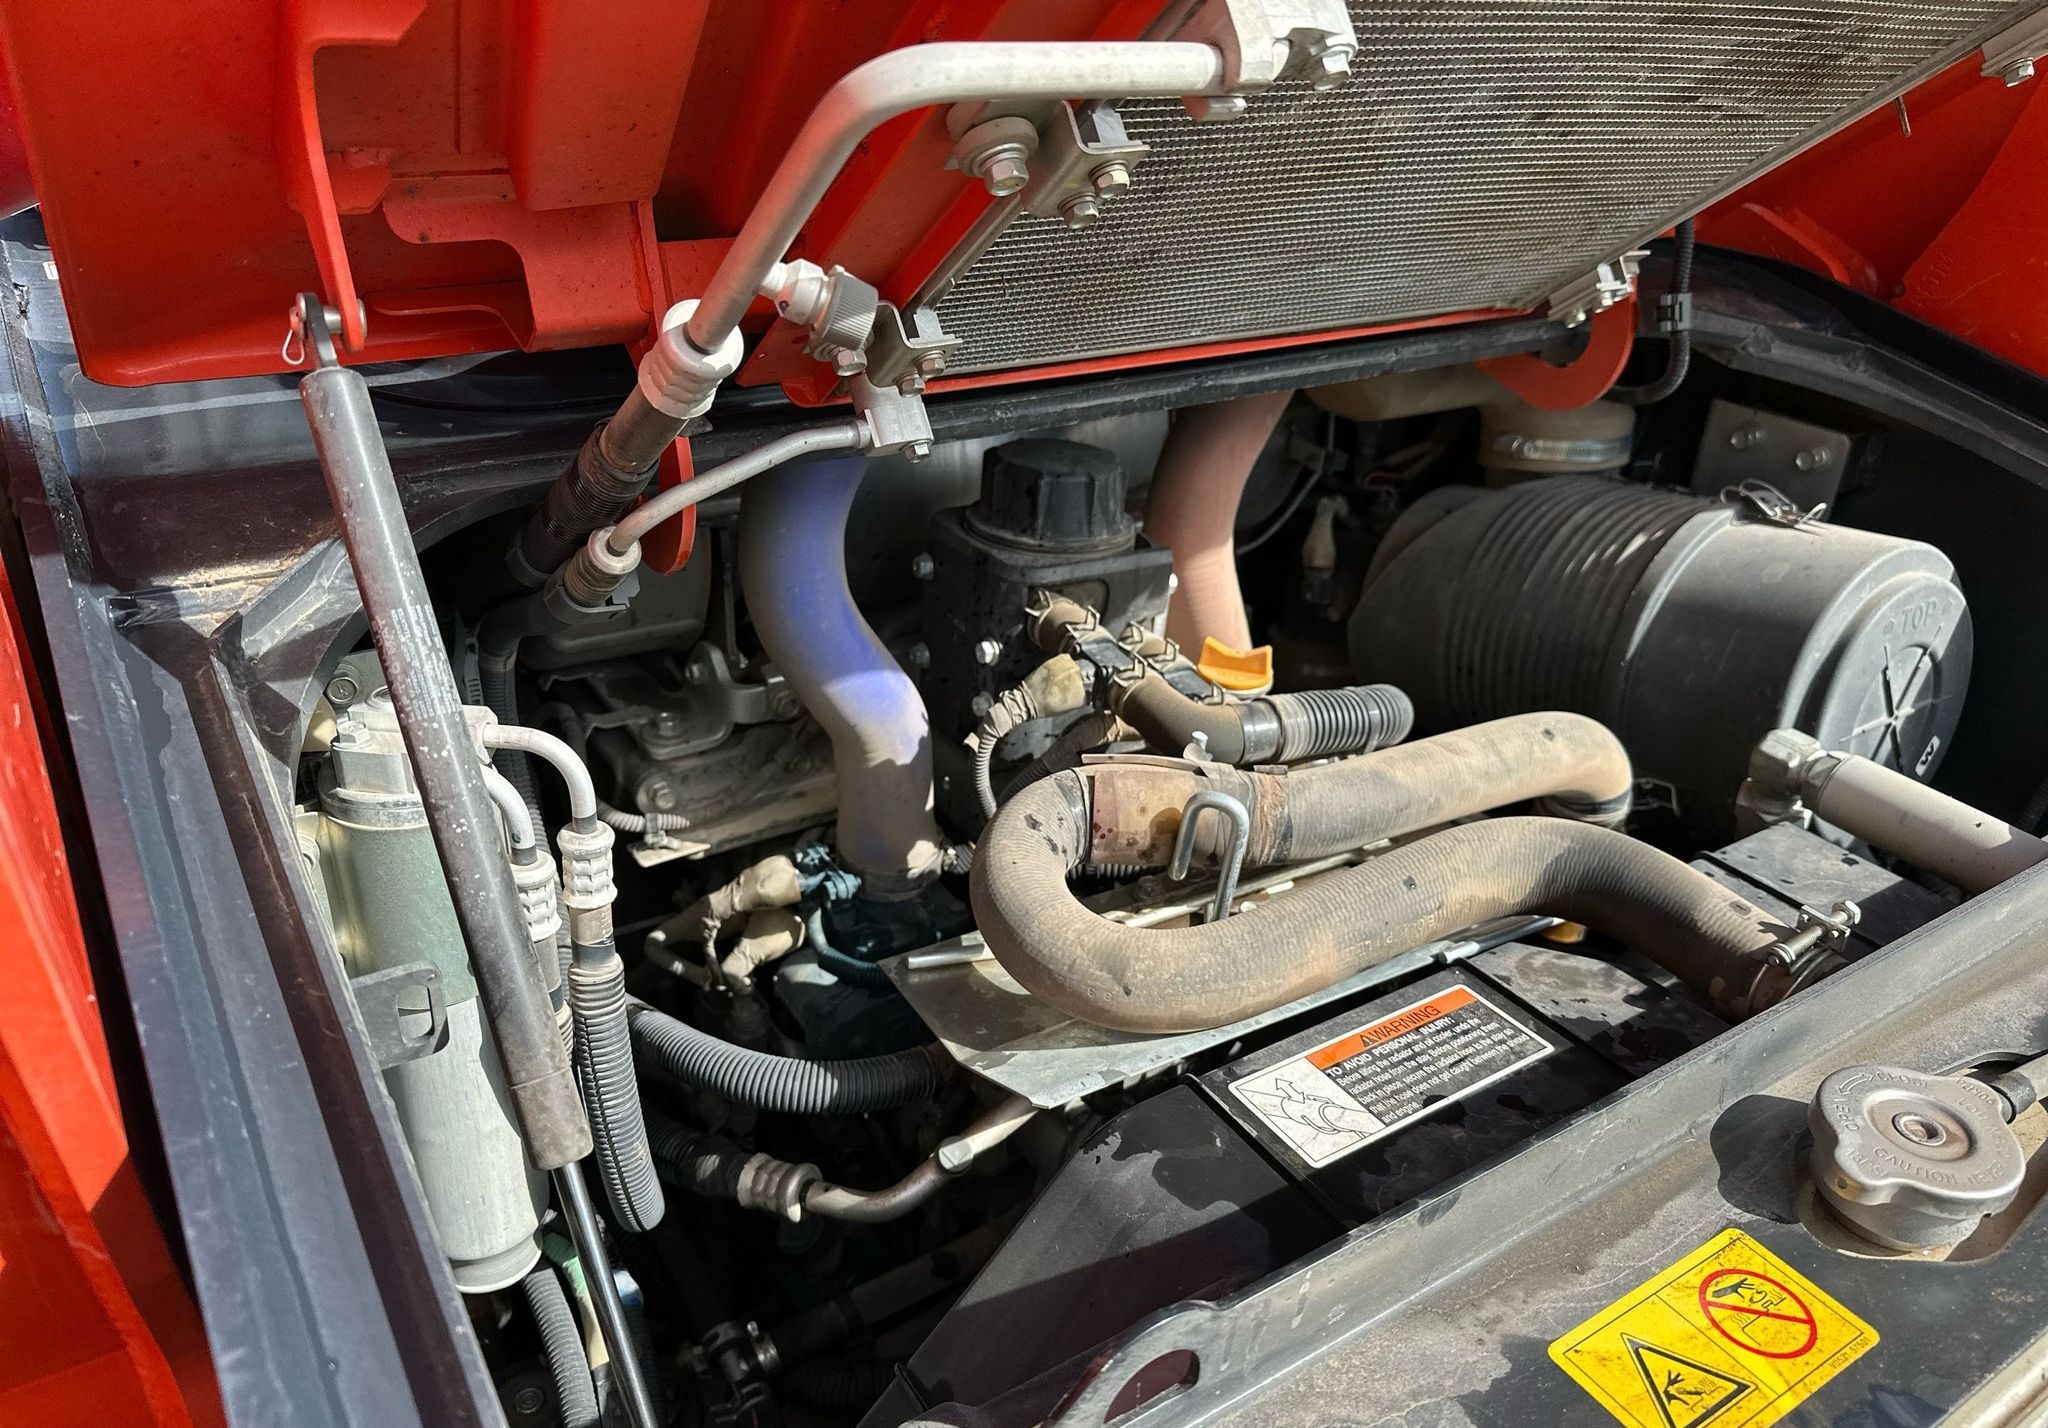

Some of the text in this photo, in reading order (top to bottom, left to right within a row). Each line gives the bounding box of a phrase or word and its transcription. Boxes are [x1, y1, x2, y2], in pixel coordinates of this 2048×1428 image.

[1902, 597, 1938, 634] TOP
[1325, 1017, 1454, 1076] TO AVOID PERSONAL INJURY:
[1336, 1072, 1361, 1086] Before
[1375, 1059, 1390, 1068] the
[1387, 1048, 1413, 1062] radiator
[1411, 1041, 1426, 1052] and
[1424, 1037, 1434, 1046] oil
[1452, 1022, 1470, 1032] undo
[1466, 1017, 1480, 1025] the
[1369, 1005, 1441, 1041] WARNING
[1348, 1079, 1375, 1094] radiator
[1371, 1072, 1391, 1083] hose
[1388, 1065, 1406, 1075] from
[1403, 1060, 1417, 1068] the
[1427, 1044, 1452, 1056] Before
[1449, 1029, 1485, 1048] positioning
[1480, 1021, 1500, 1032] them
[1357, 1092, 1378, 1104] back
[1402, 1069, 1426, 1083] secure
[1422, 1064, 1437, 1073] the
[1434, 1053, 1460, 1068] radiator
[1455, 1046, 1475, 1057] hose
[1478, 1038, 1493, 1046] the
[1490, 1031, 1507, 1041] stay
[1369, 1033, 1529, 1113] that the hose does not get caught between the shroud
[1381, 1110, 1397, 1123] and
[1872, 1146, 1958, 1186] CAUTION
